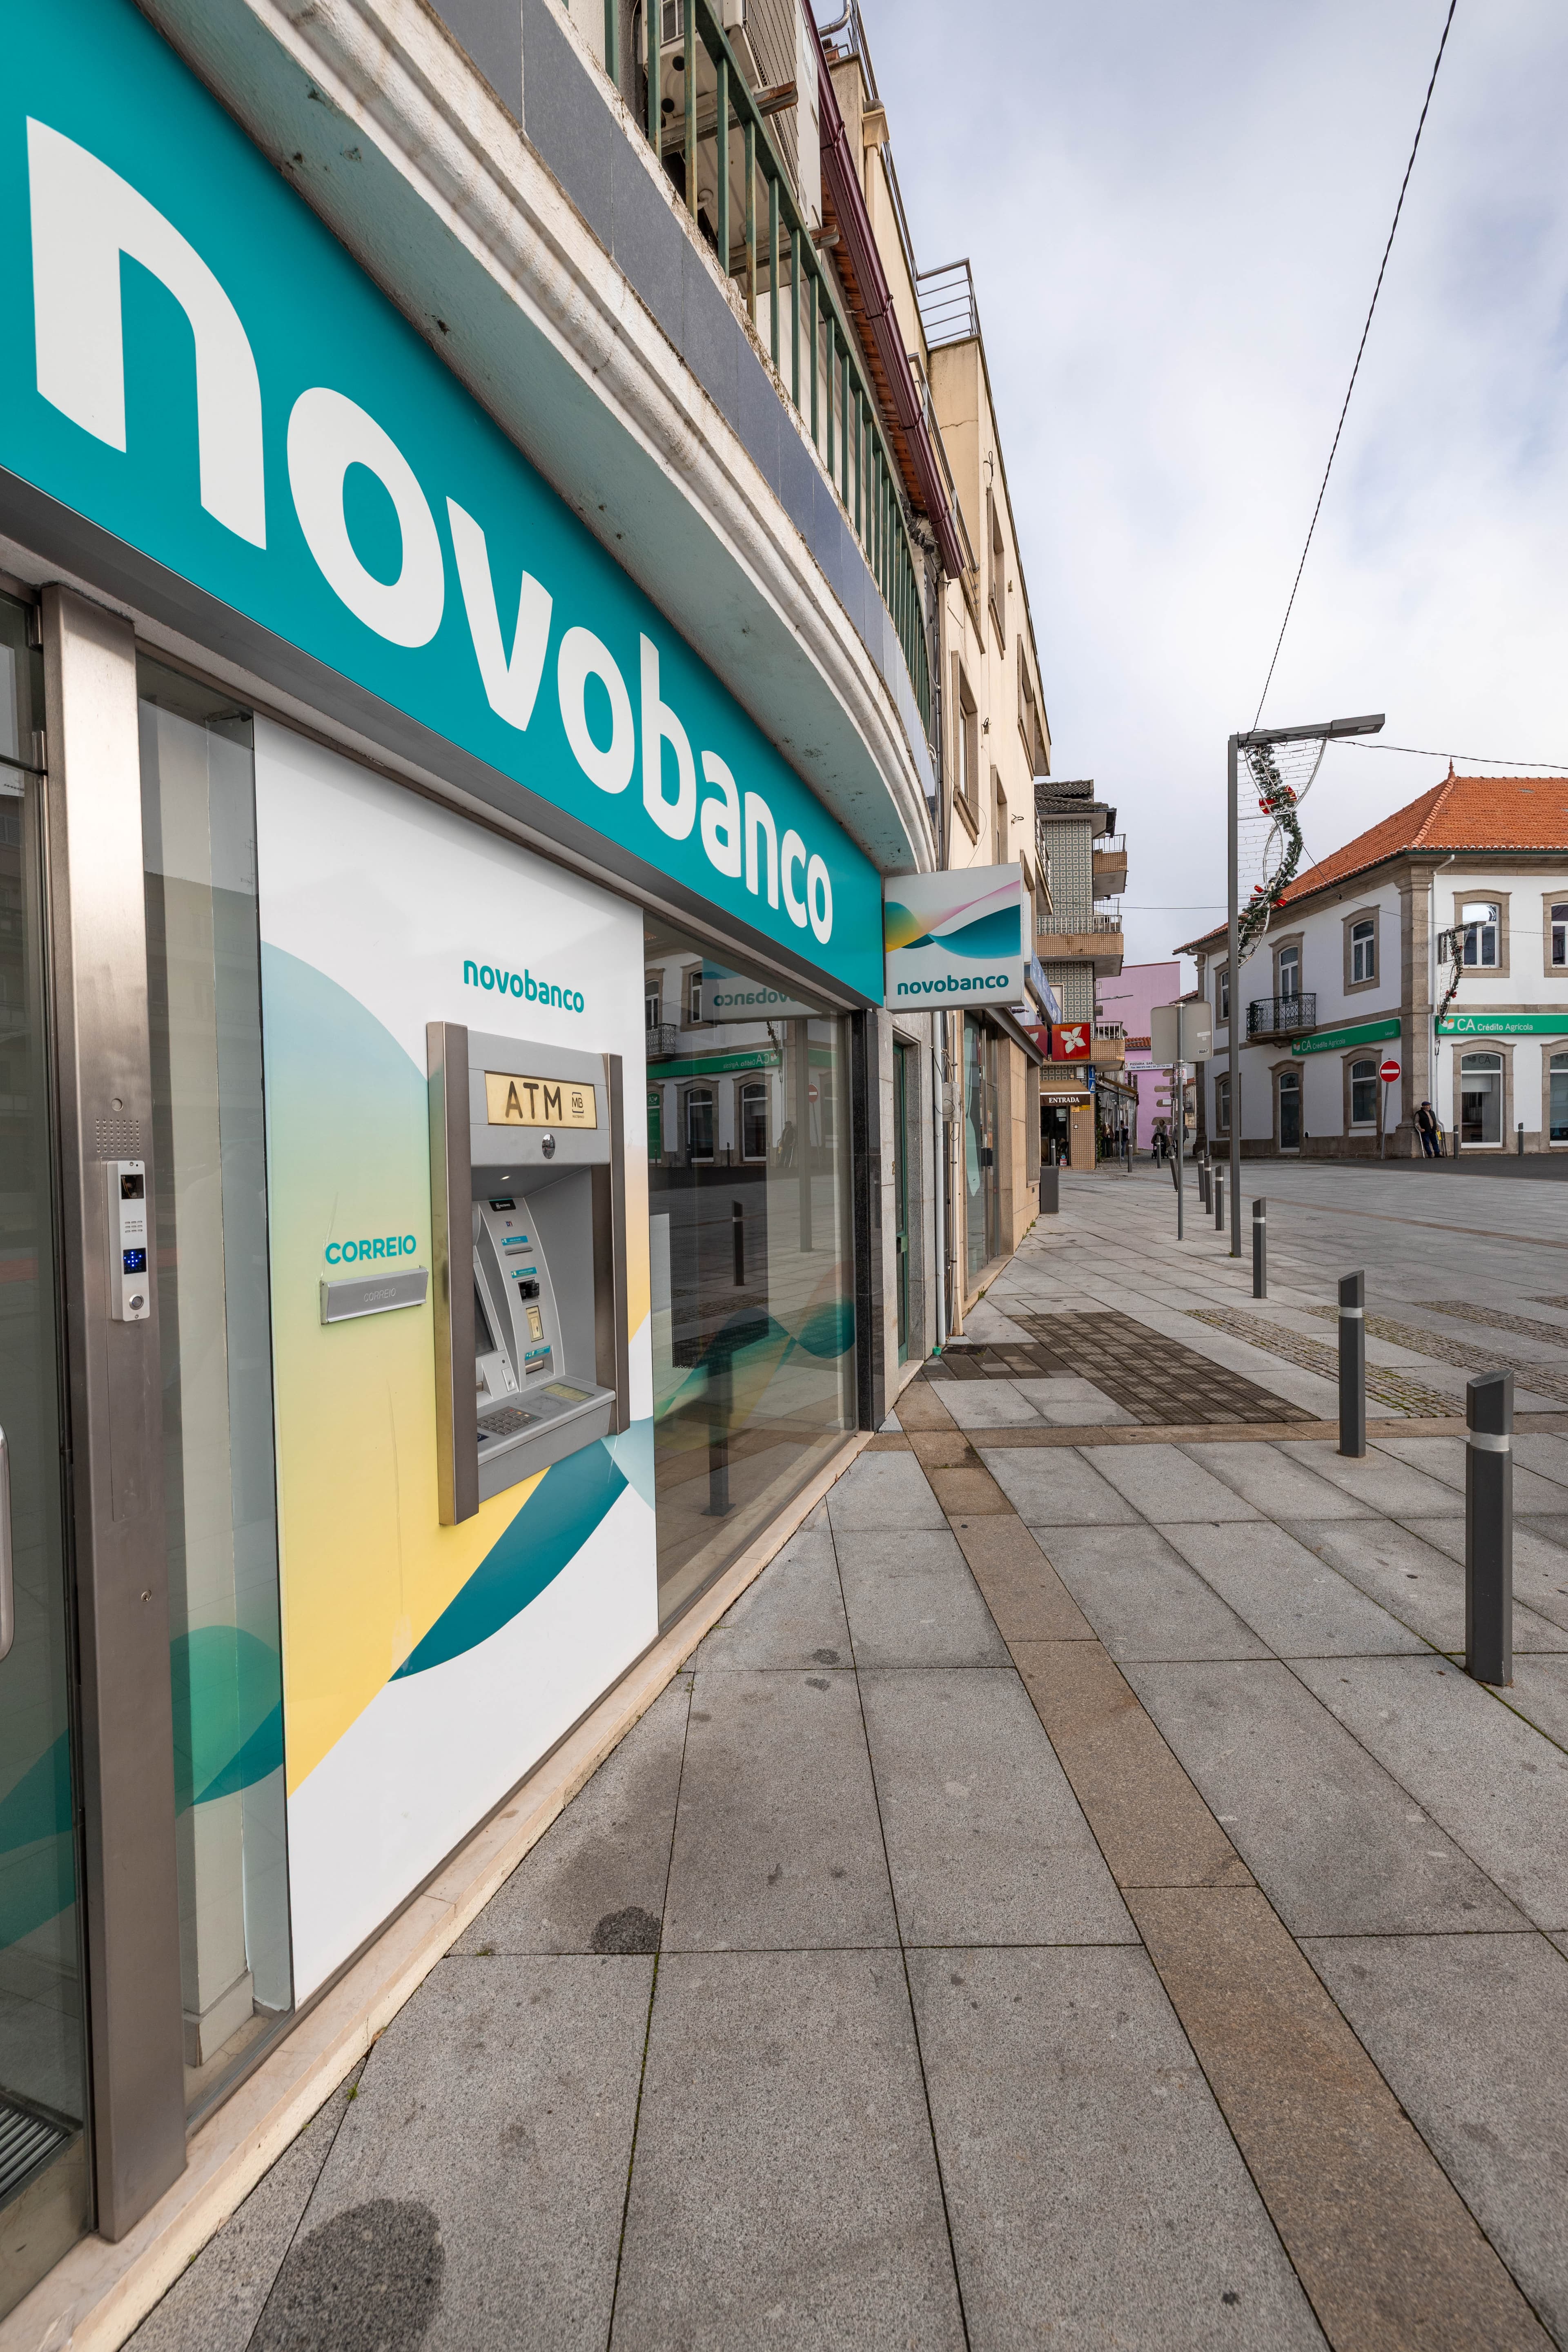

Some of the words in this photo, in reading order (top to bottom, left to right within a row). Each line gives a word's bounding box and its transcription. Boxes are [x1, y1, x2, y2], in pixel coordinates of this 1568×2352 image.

[27, 115, 833, 944] novobanco
[464, 960, 584, 1013] novobanco
[898, 975, 1009, 995] novobanco
[1457, 1019, 1475, 1031] CA
[1506, 1022, 1533, 1032] Agrícola
[1301, 1040, 1312, 1051] CA
[1313, 1042, 1327, 1050] Crédito
[1329, 1038, 1345, 1047] Agrícola
[1479, 1056, 1491, 1064] CA
[505, 1081, 562, 1121] ATM
[572, 1097, 583, 1108] MB
[326, 1235, 416, 1264] CORREIO
[364, 1288, 396, 1302] CORREIO
